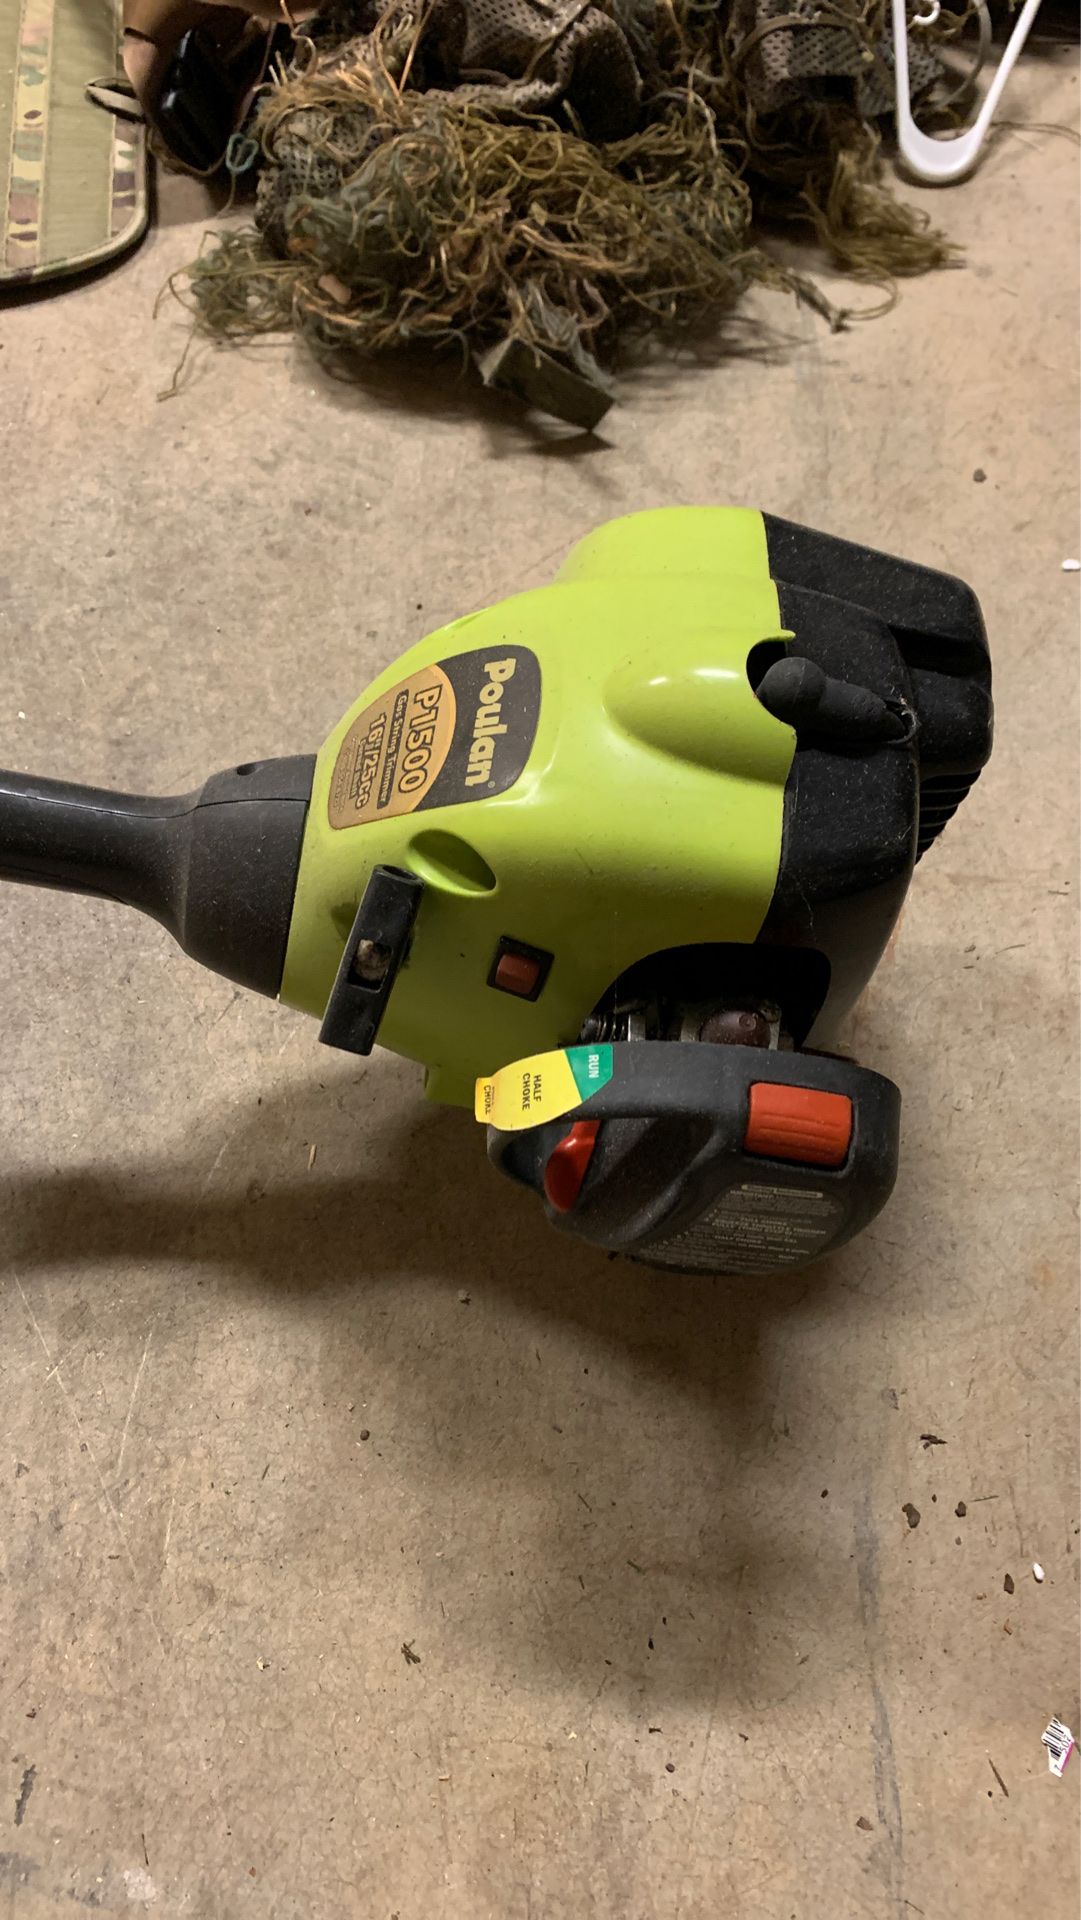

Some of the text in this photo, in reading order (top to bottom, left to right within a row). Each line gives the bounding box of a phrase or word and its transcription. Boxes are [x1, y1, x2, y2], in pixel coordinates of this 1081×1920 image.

[381, 694, 408, 802] Gas String Trimmer
[398, 684, 443, 793] P1500
[464, 657, 517, 787] Poulan
[521, 1072, 531, 1112] CHOKE
[532, 1074, 542, 1102] HALF
[588, 1054, 600, 1079] RUN
